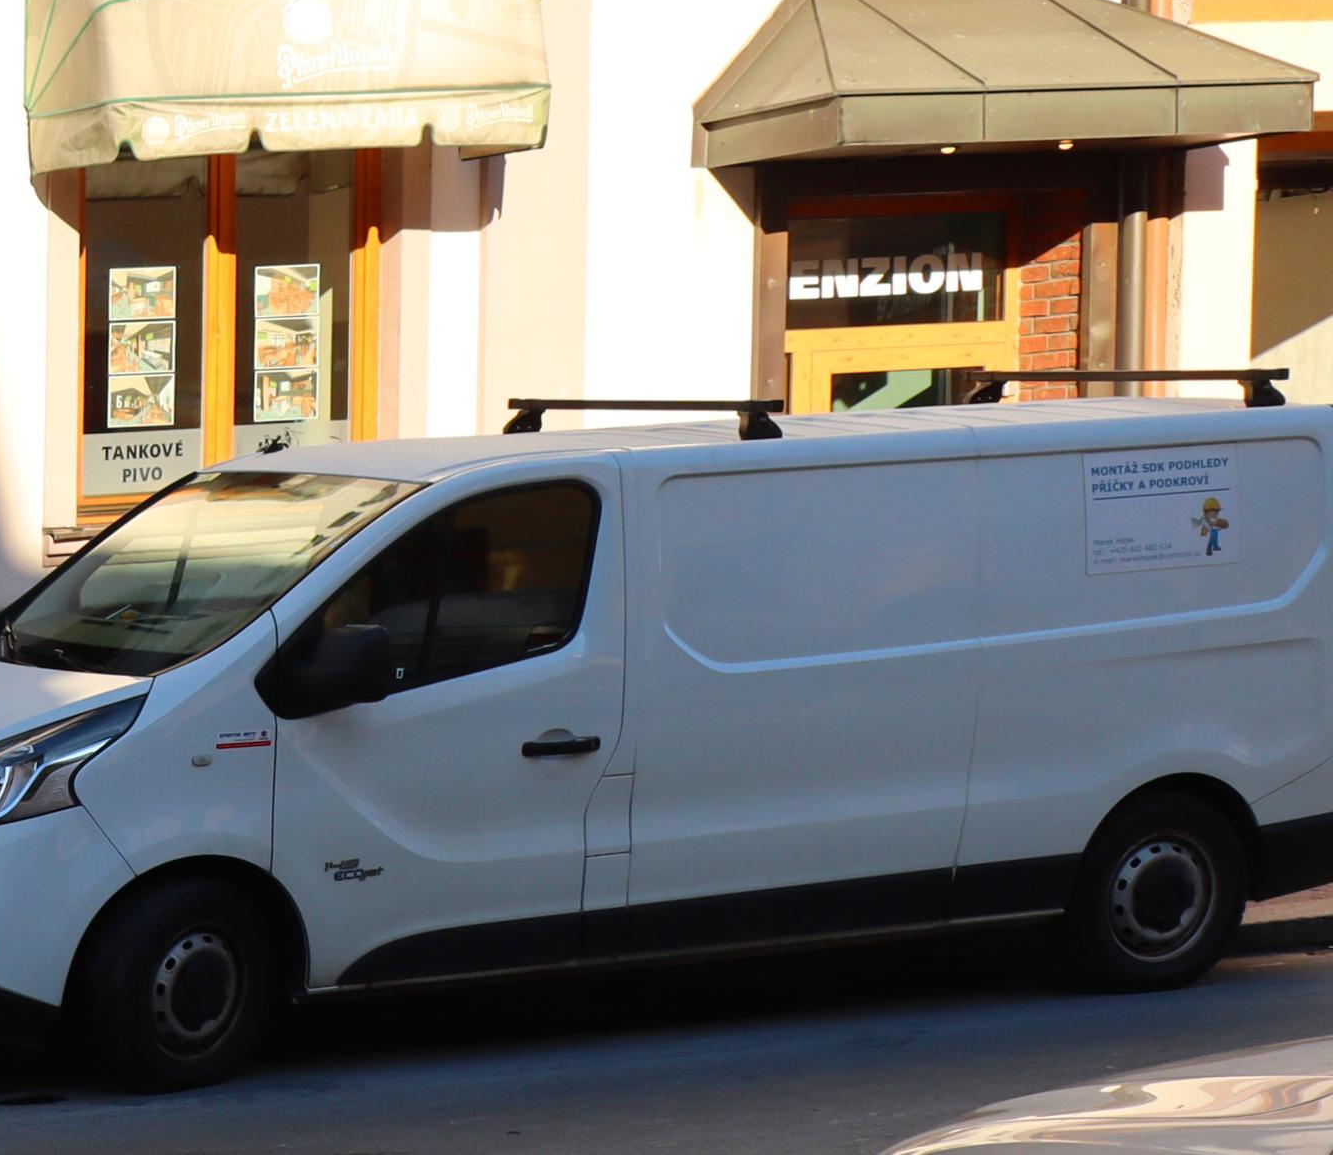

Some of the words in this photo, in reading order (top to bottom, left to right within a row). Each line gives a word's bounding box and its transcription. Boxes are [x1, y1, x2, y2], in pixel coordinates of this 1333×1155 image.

[789, 252, 983, 301] ENZION
[102, 440, 184, 462] TANKOVÉ
[122, 466, 163, 484] PIVO
[1091, 461, 1139, 477] MONTÁŽ
[1142, 462, 1166, 473] SDK
[1169, 457, 1229, 471] PODHLEDY
[1092, 479, 1134, 494] PŘÍČKY
[1138, 480, 1147, 490] A
[1149, 474, 1210, 490] PODKROVÍ
